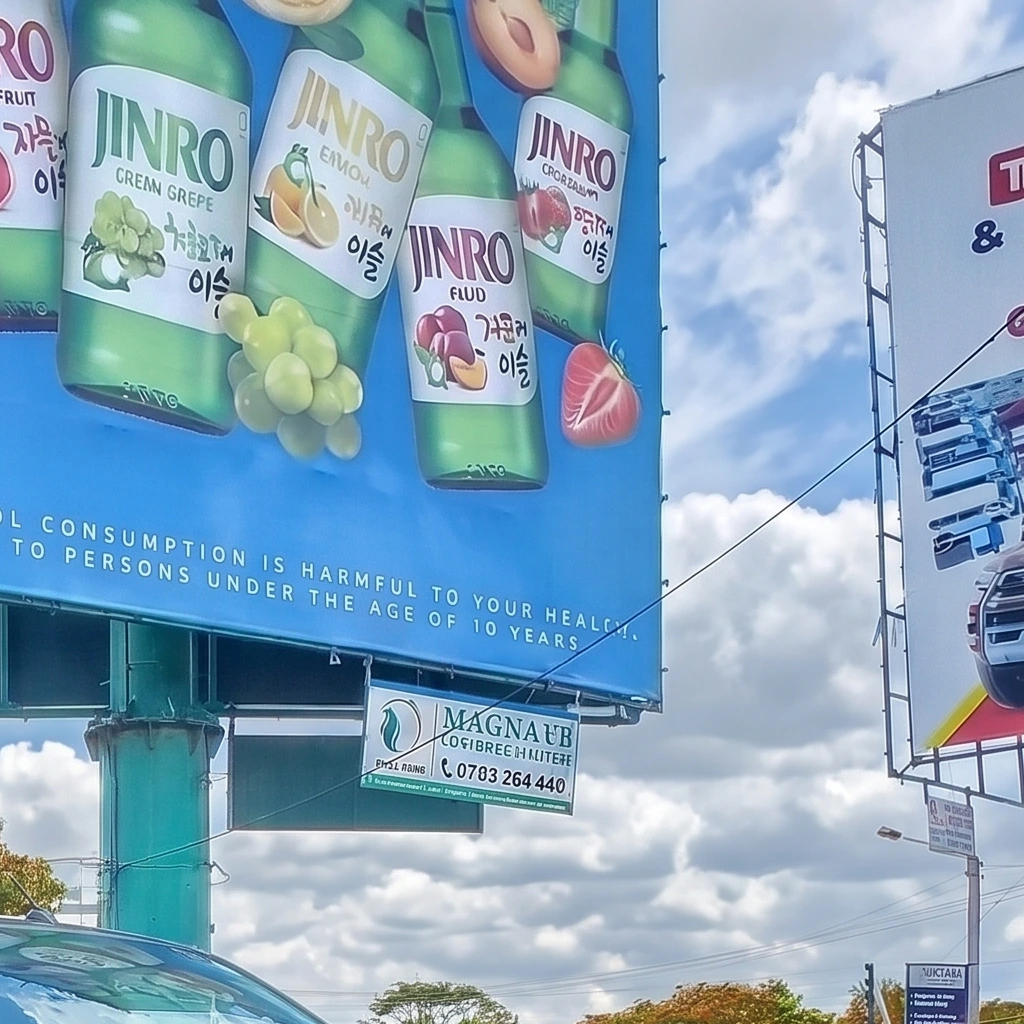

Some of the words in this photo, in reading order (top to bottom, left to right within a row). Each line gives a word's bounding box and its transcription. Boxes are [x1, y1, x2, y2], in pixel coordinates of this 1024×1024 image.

[91, 88, 234, 192] JINRO
[287, 67, 410, 183] JINRO
[527, 112, 616, 192] JINRO
[409, 225, 515, 292] JINRO
[971, 220, 1005, 254] &
[12, 538, 45, 560] TO
[65, 547, 190, 584] PERSONS
[207, 571, 293, 602] UNDER
[309, 589, 354, 612] THE
[369, 600, 414, 623] AGE
[428, 611, 456, 630] OF
[509, 625, 579, 651] YEARS
[41, 515, 245, 567] CONSUMPTION
[262, 554, 284, 574] IS
[301, 561, 417, 598] HARMFUL
[431, 585, 459, 606] TO
[472, 593, 533, 619] YOUR
[502, 769, 532, 789] 264
[535, 775, 566, 794] 440
